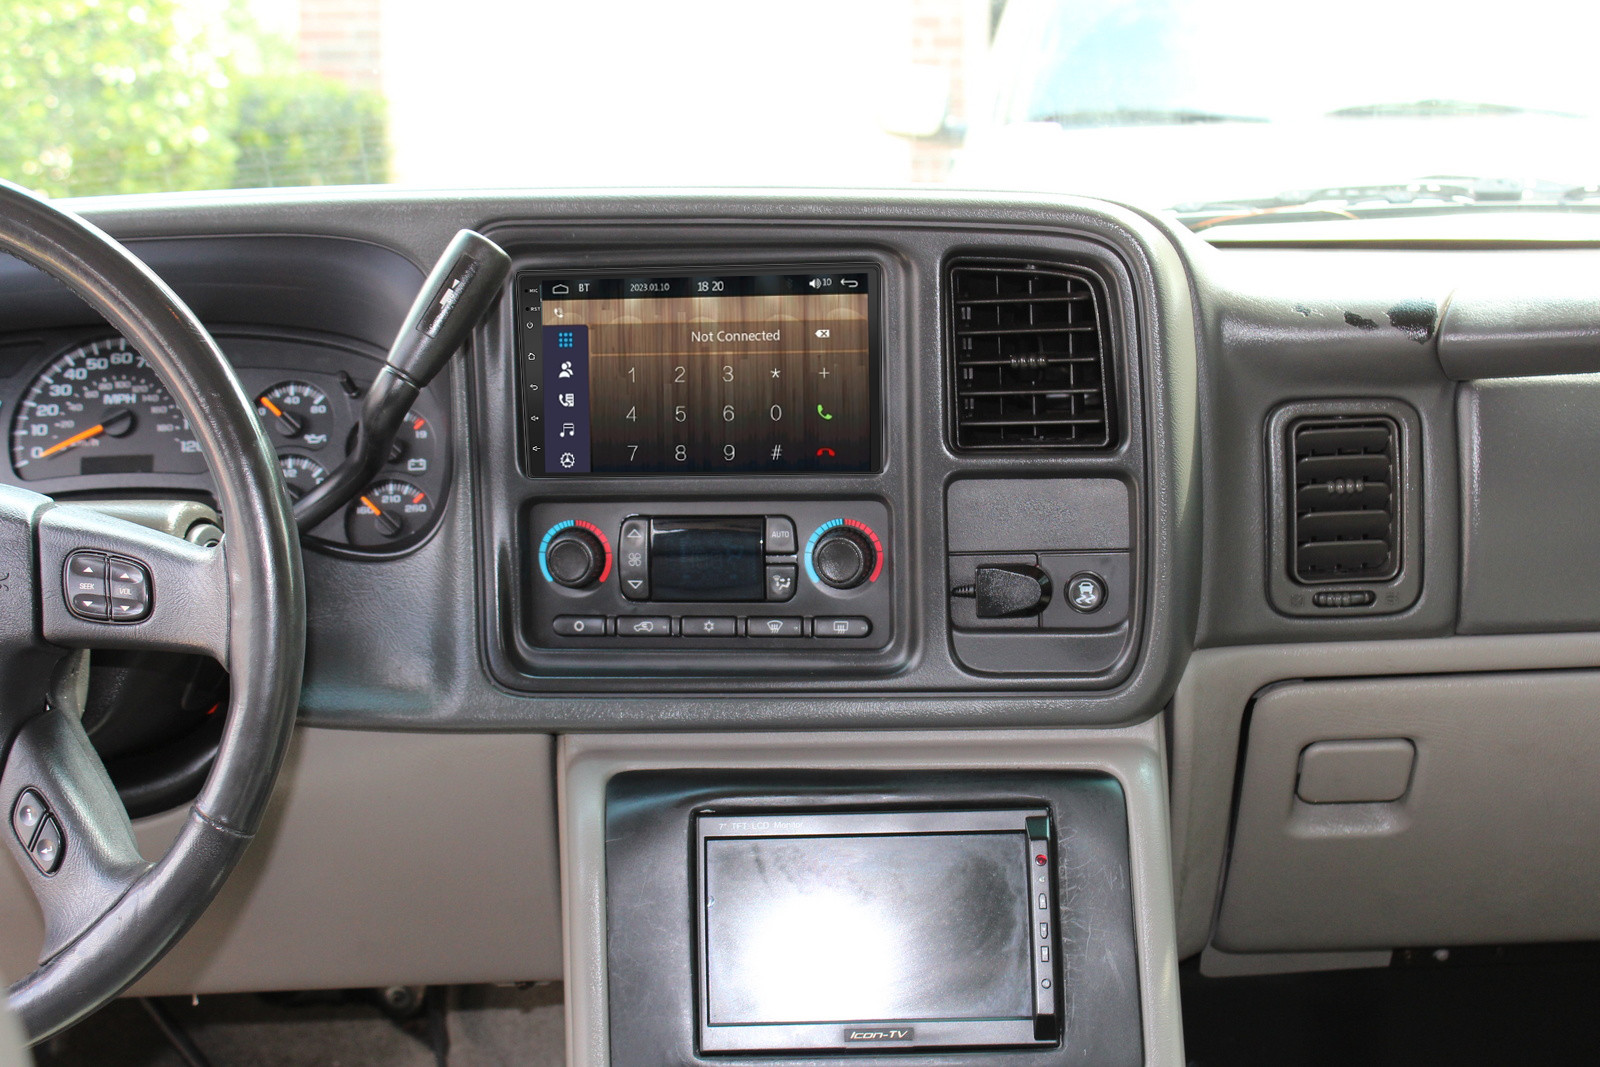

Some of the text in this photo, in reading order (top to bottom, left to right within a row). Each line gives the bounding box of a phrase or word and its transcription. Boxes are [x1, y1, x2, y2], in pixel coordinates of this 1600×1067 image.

[578, 283, 590, 293] BT
[630, 283, 670, 292] 2023.01.10
[697, 281, 724, 292] 18 20
[822, 278, 832, 287] 10
[691, 330, 780, 343] Not Connected
[85, 357, 109, 370] 50
[110, 352, 133, 365] 60
[63, 368, 88, 380] 40
[628, 367, 636, 383] 1
[674, 367, 686, 382] 2
[723, 366, 734, 382] 3
[49, 384, 72, 396] 30
[103, 393, 136, 405] MPH
[283, 396, 301, 404] 40
[35, 404, 59, 416] 20
[626, 404, 782, 422] 4 5 6 0
[31, 424, 48, 436] 10
[415, 431, 427, 439] 19
[31, 446, 43, 459] 0
[627, 444, 782, 461] 7 8 9 #
[381, 495, 402, 503] 210
[405, 504, 427, 513] 260
[79, 582, 95, 590] SEEK
[119, 587, 131, 595] VOL
[732, 822, 747, 830] TFT
[752, 821, 770, 830] LCD
[850, 1030, 908, 1039] Icon-TV
